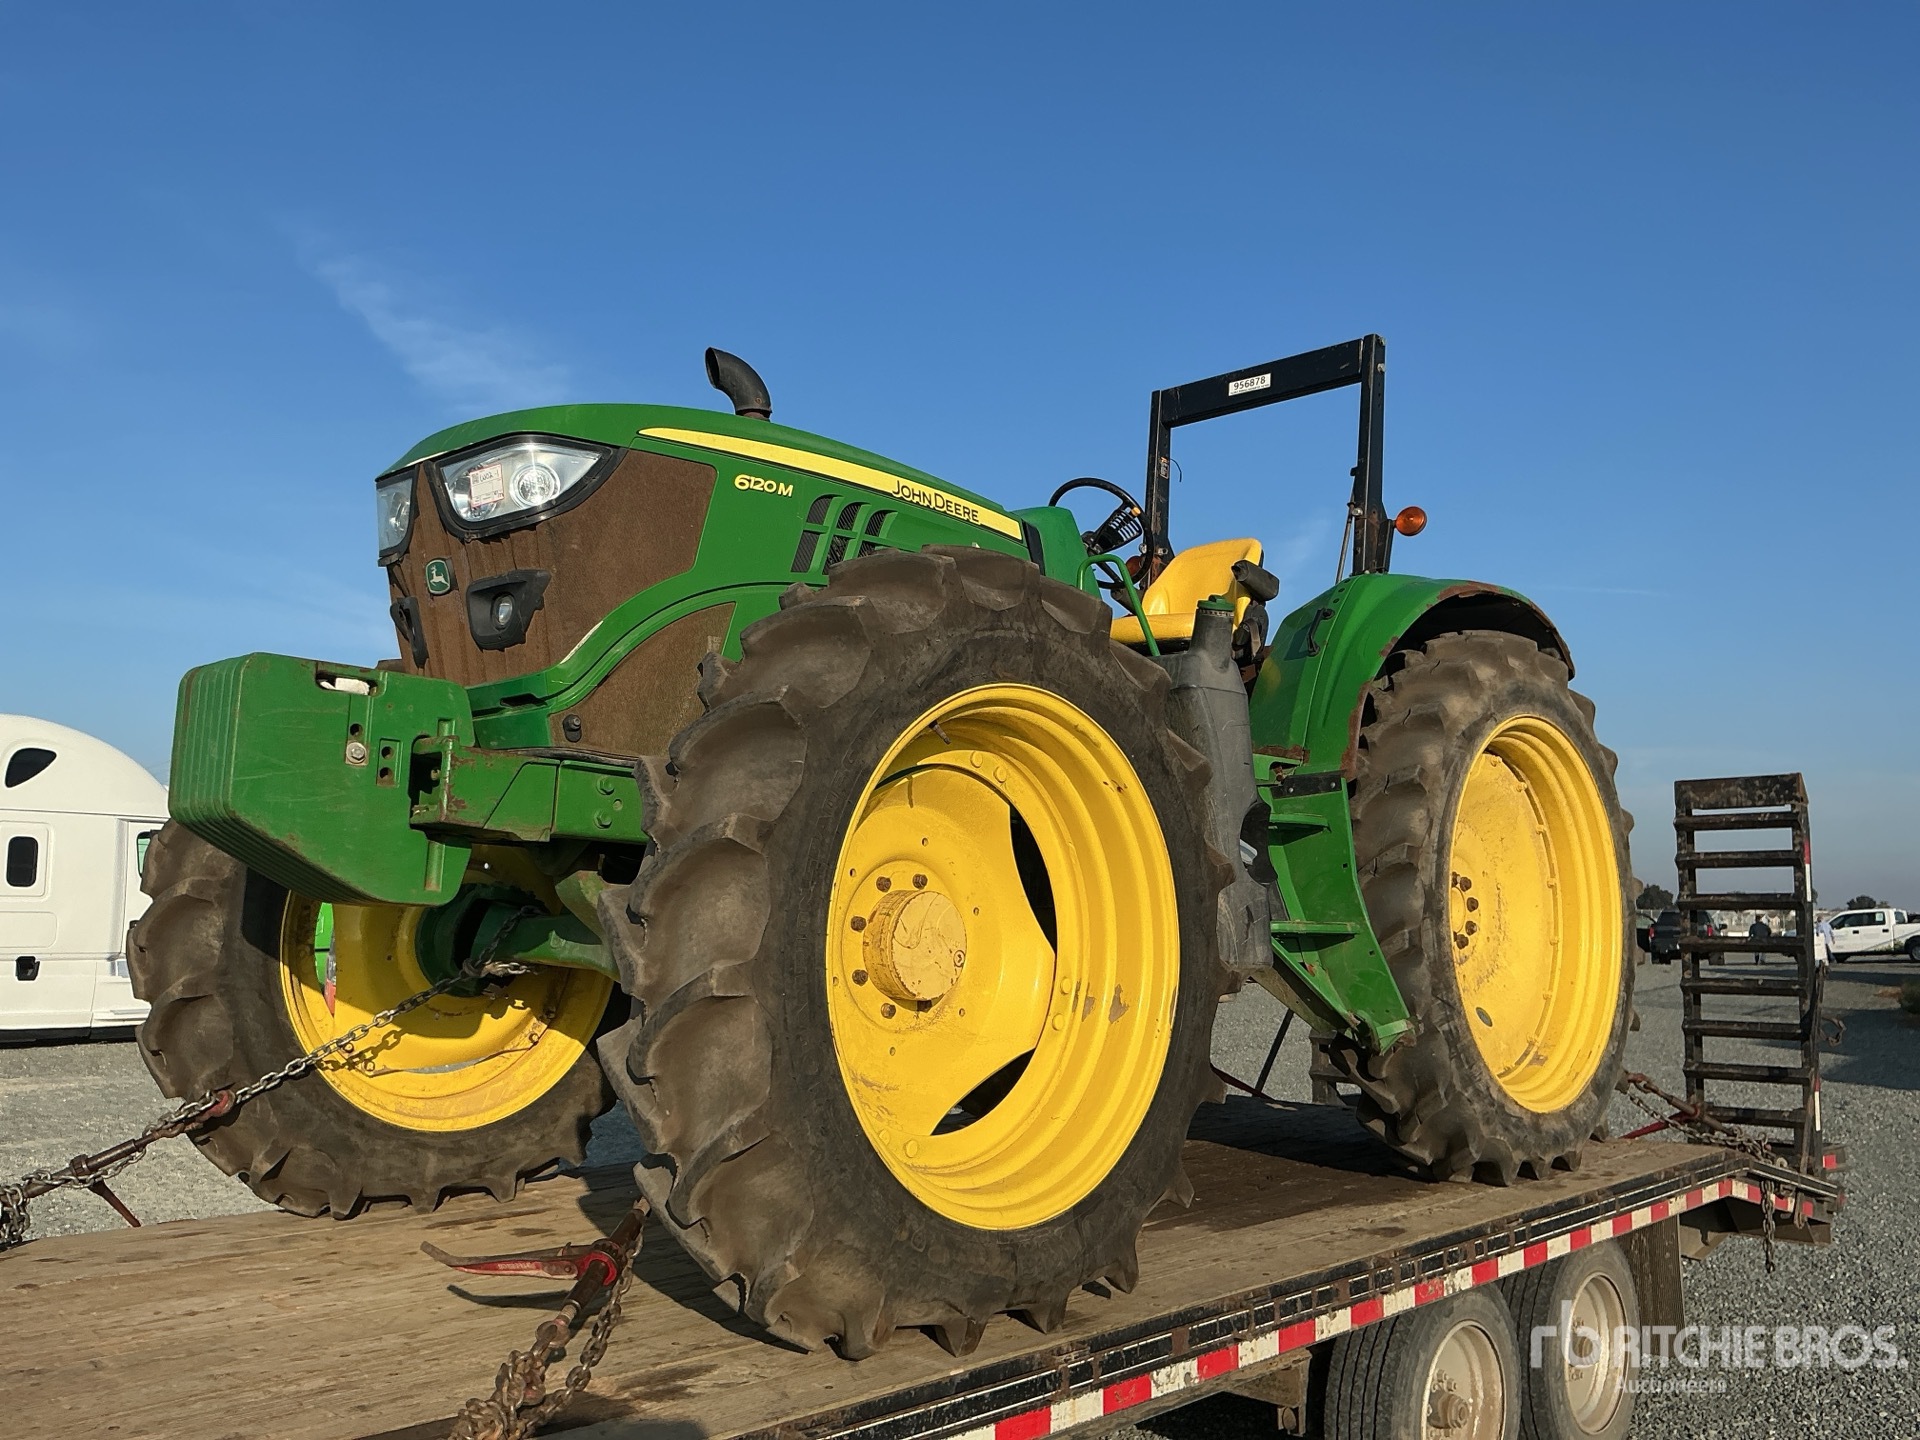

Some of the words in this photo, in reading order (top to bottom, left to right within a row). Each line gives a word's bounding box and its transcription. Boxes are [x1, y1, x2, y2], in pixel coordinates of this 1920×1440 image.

[1233, 375, 1266, 391] 956878
[734, 474, 794, 497] 6120M
[892, 480, 932, 506] JOHN
[934, 492, 979, 523] DEERE
